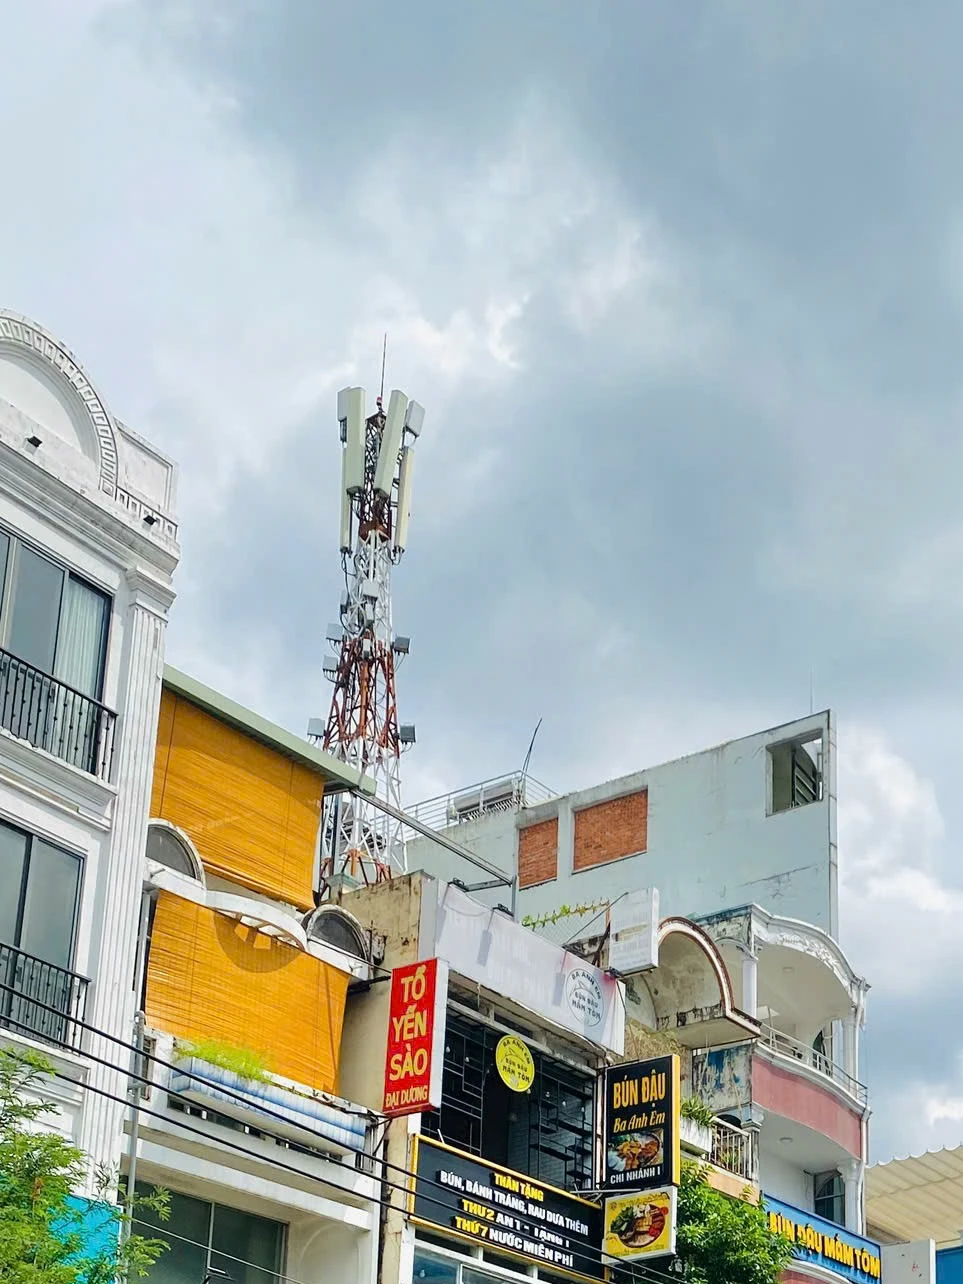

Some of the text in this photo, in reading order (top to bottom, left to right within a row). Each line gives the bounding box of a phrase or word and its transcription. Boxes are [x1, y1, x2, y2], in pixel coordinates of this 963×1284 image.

[389, 1047, 428, 1082] SÀO
[613, 1068, 666, 1110] BÚN ĐẬU
[613, 1110, 666, 1134] Ba Anh Em
[610, 1173, 625, 1185] CHI
[485, 1207, 496, 1221] 2
[528, 1202, 546, 1220] RAU
[480, 1225, 489, 1238] 7
